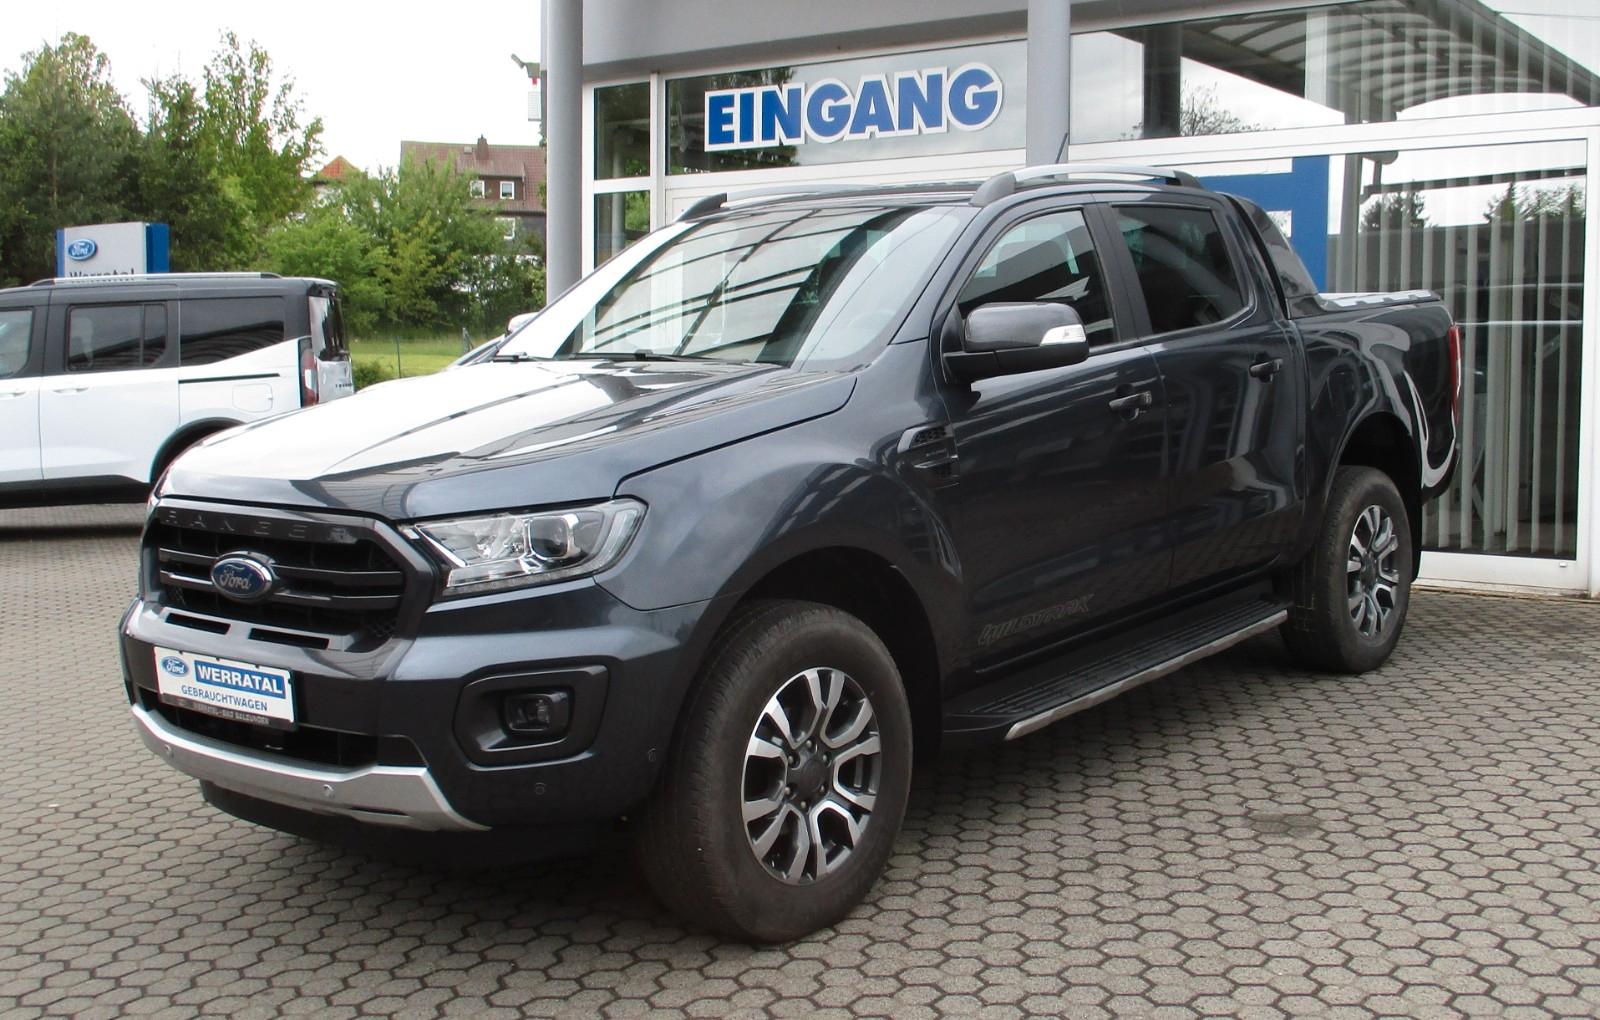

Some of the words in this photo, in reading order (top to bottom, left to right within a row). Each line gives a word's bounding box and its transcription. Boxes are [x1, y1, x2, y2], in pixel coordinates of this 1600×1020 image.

[705, 62, 1003, 151] EINGANG
[219, 563, 253, 590] Ford
[165, 659, 186, 675] Ford
[196, 664, 284, 694] WERRATAL
[181, 684, 268, 712] GEBRAUCHTWAGEN
